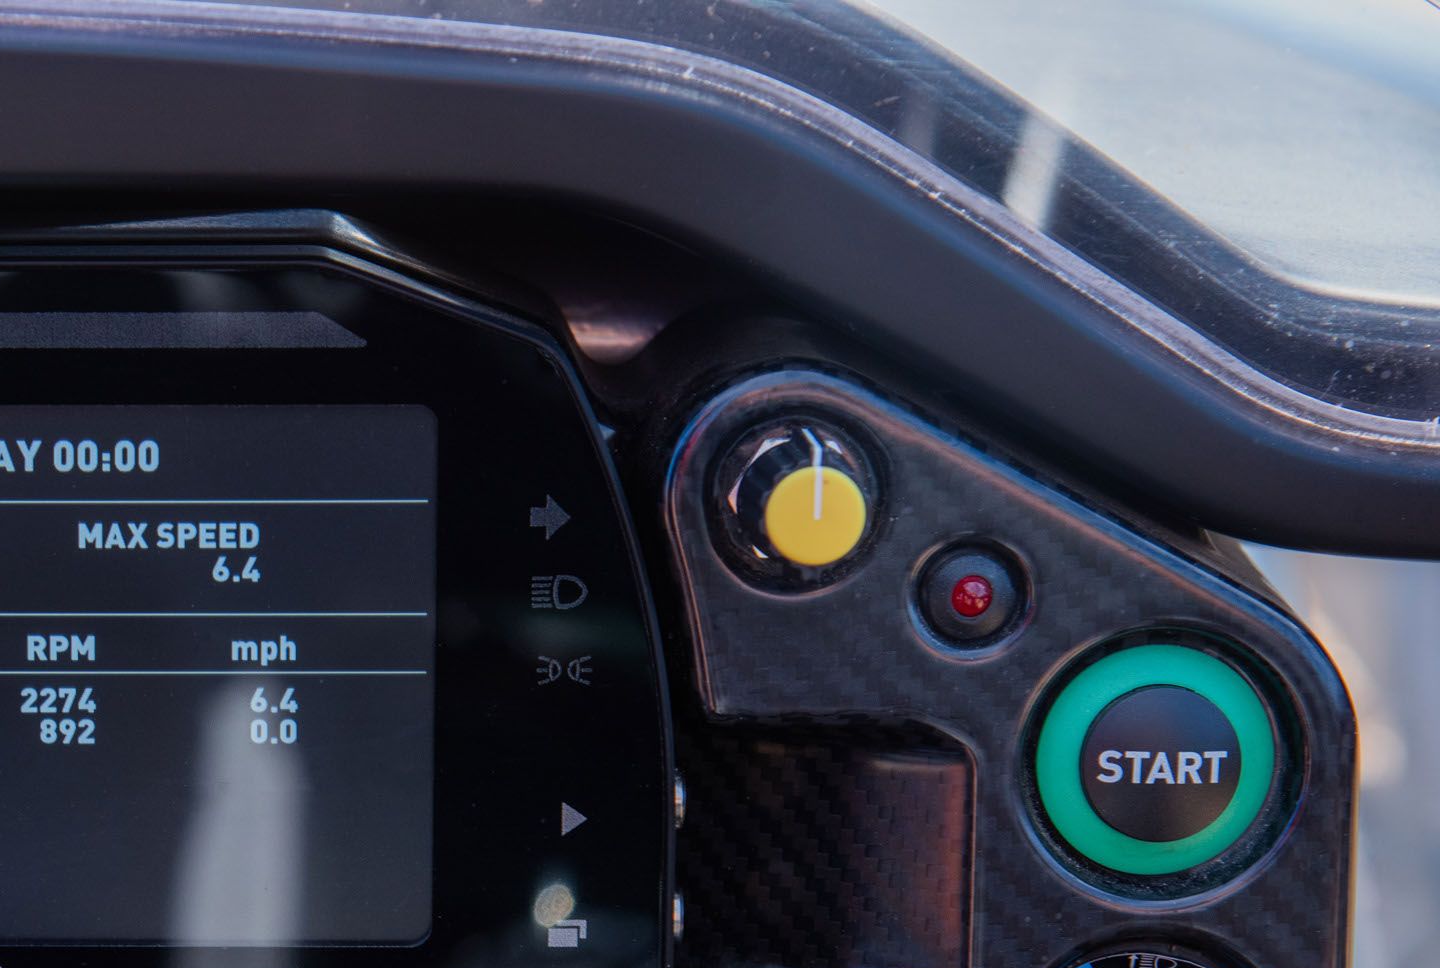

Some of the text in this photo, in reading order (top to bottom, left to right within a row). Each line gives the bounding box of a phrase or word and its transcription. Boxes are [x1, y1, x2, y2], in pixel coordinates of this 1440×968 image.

[53, 439, 160, 473] 00:00
[77, 522, 260, 549] MAX SPEED
[212, 556, 261, 583] 6.4
[26, 635, 96, 662] RPM
[231, 635, 297, 667] mph
[20, 687, 97, 714] 2274
[250, 687, 298, 714] 6.4
[39, 718, 96, 745] 892
[250, 718, 297, 745] 0.0
[1096, 749, 1228, 785] START
